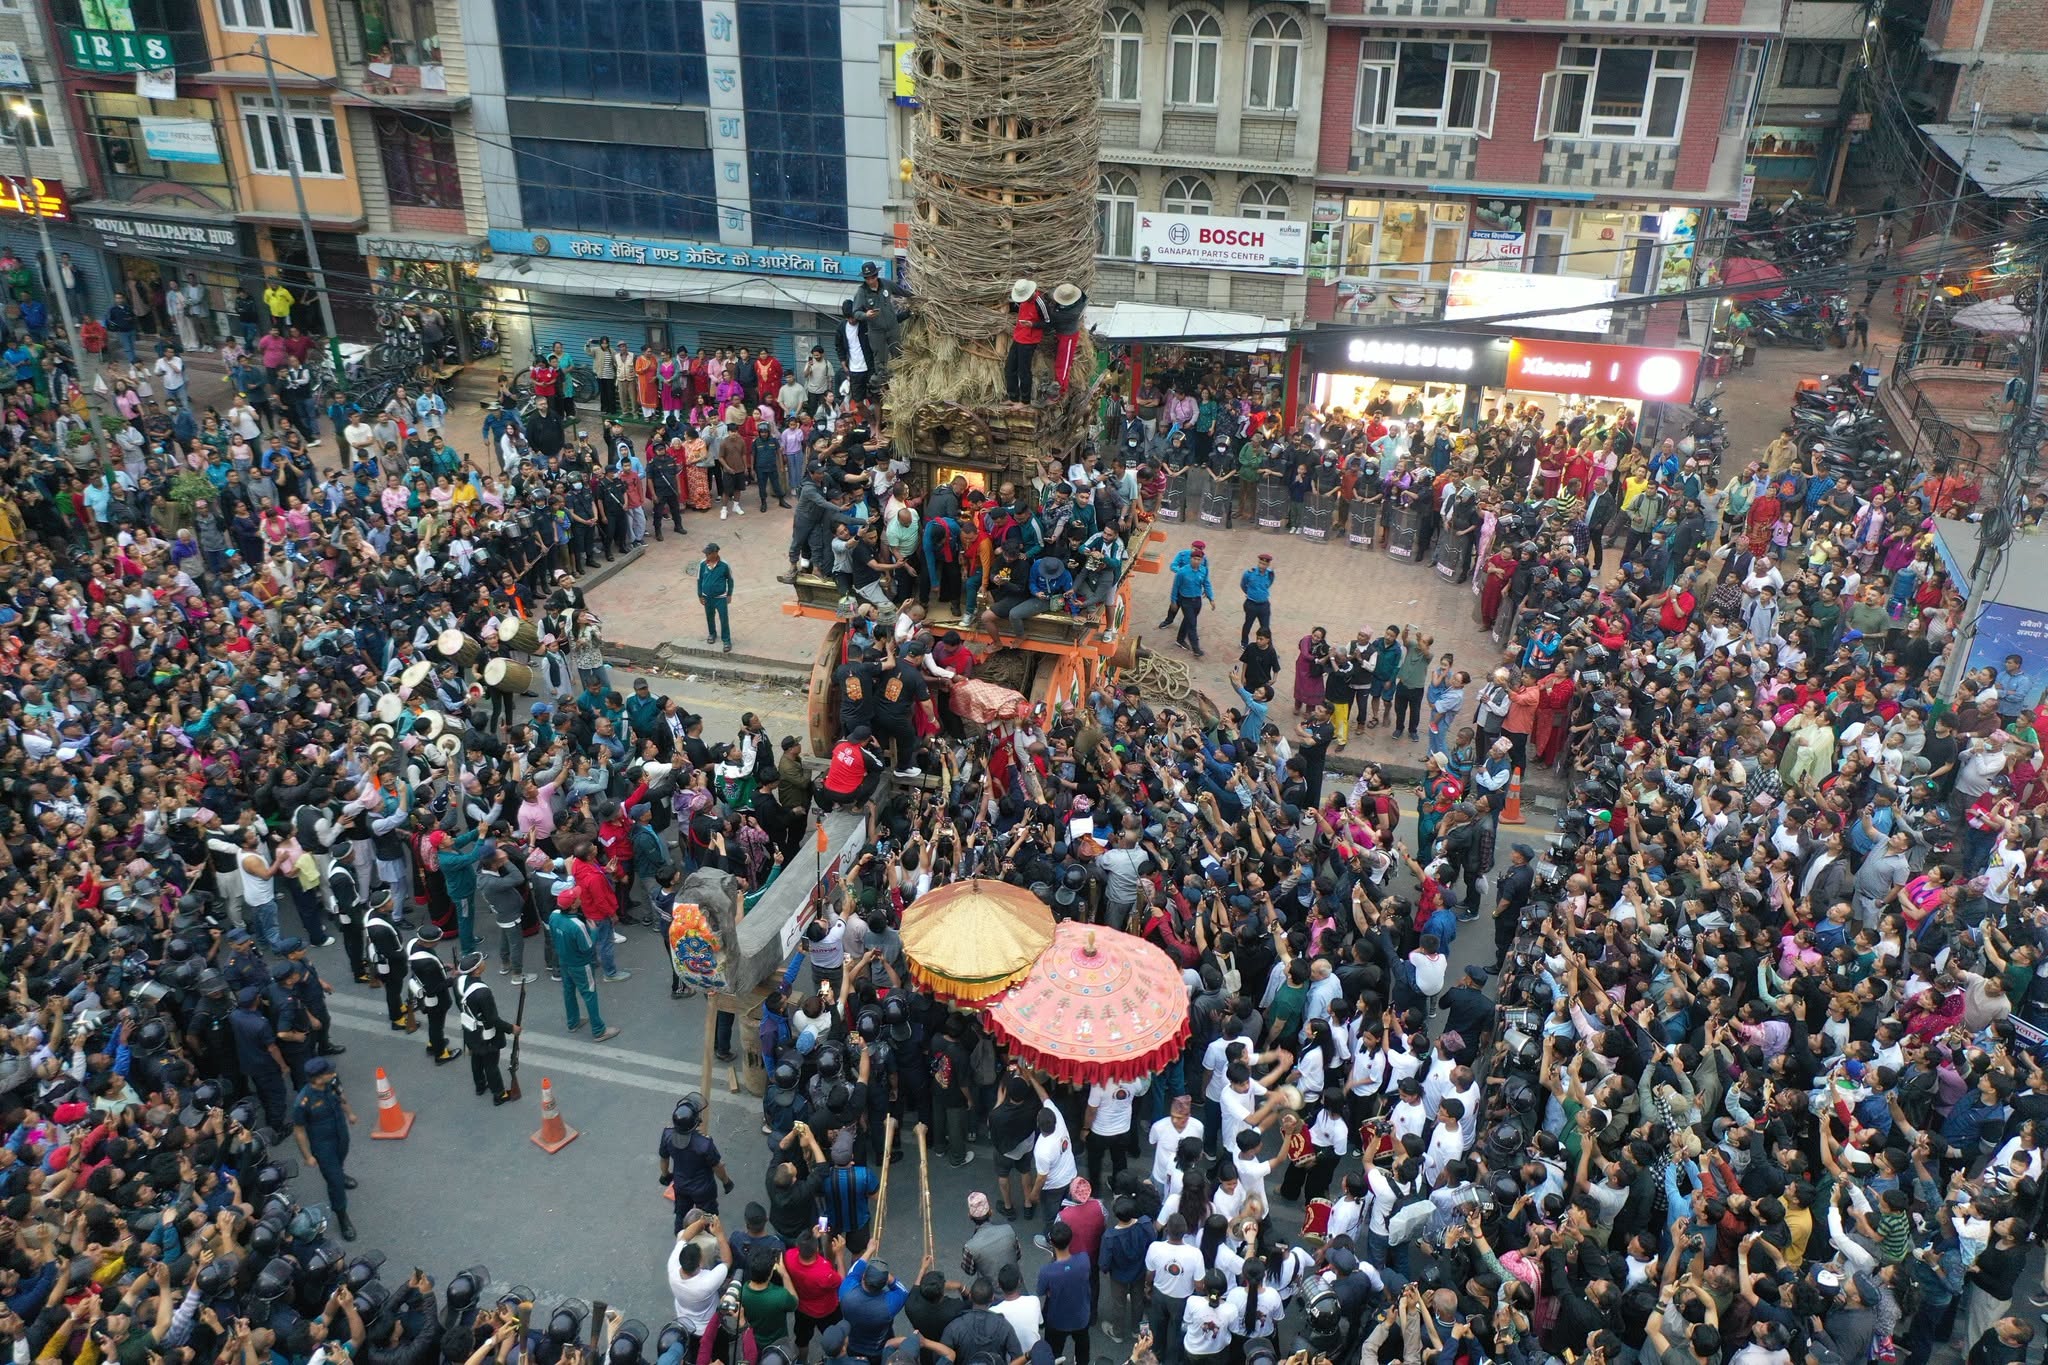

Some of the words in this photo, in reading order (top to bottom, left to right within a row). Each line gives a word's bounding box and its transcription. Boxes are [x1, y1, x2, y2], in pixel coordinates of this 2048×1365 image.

[73, 34, 167, 59] IRIS
[93, 218, 135, 235] ROYAL
[134, 222, 206, 242] WALLPAPER
[207, 229, 235, 245] HUB
[1199, 228, 1264, 247] BOSCH
[653, 247, 679, 261] एण्ड
[686, 247, 727, 264] क्रेडिट
[820, 256, 843, 274] लि.
[1158, 247, 1199, 257] GANAPATI
[1202, 249, 1228, 258] PARTS
[1231, 252, 1264, 261] CENTER
[1349, 340, 1472, 369] SAMSUNG
[1521, 357, 1591, 378] Xiaomi
[1259, 518, 1280, 527] POLICE
[1303, 527, 1324, 537] POLICE
[1350, 534, 1371, 544] POLICE
[1390, 546, 1411, 556] POLICE
